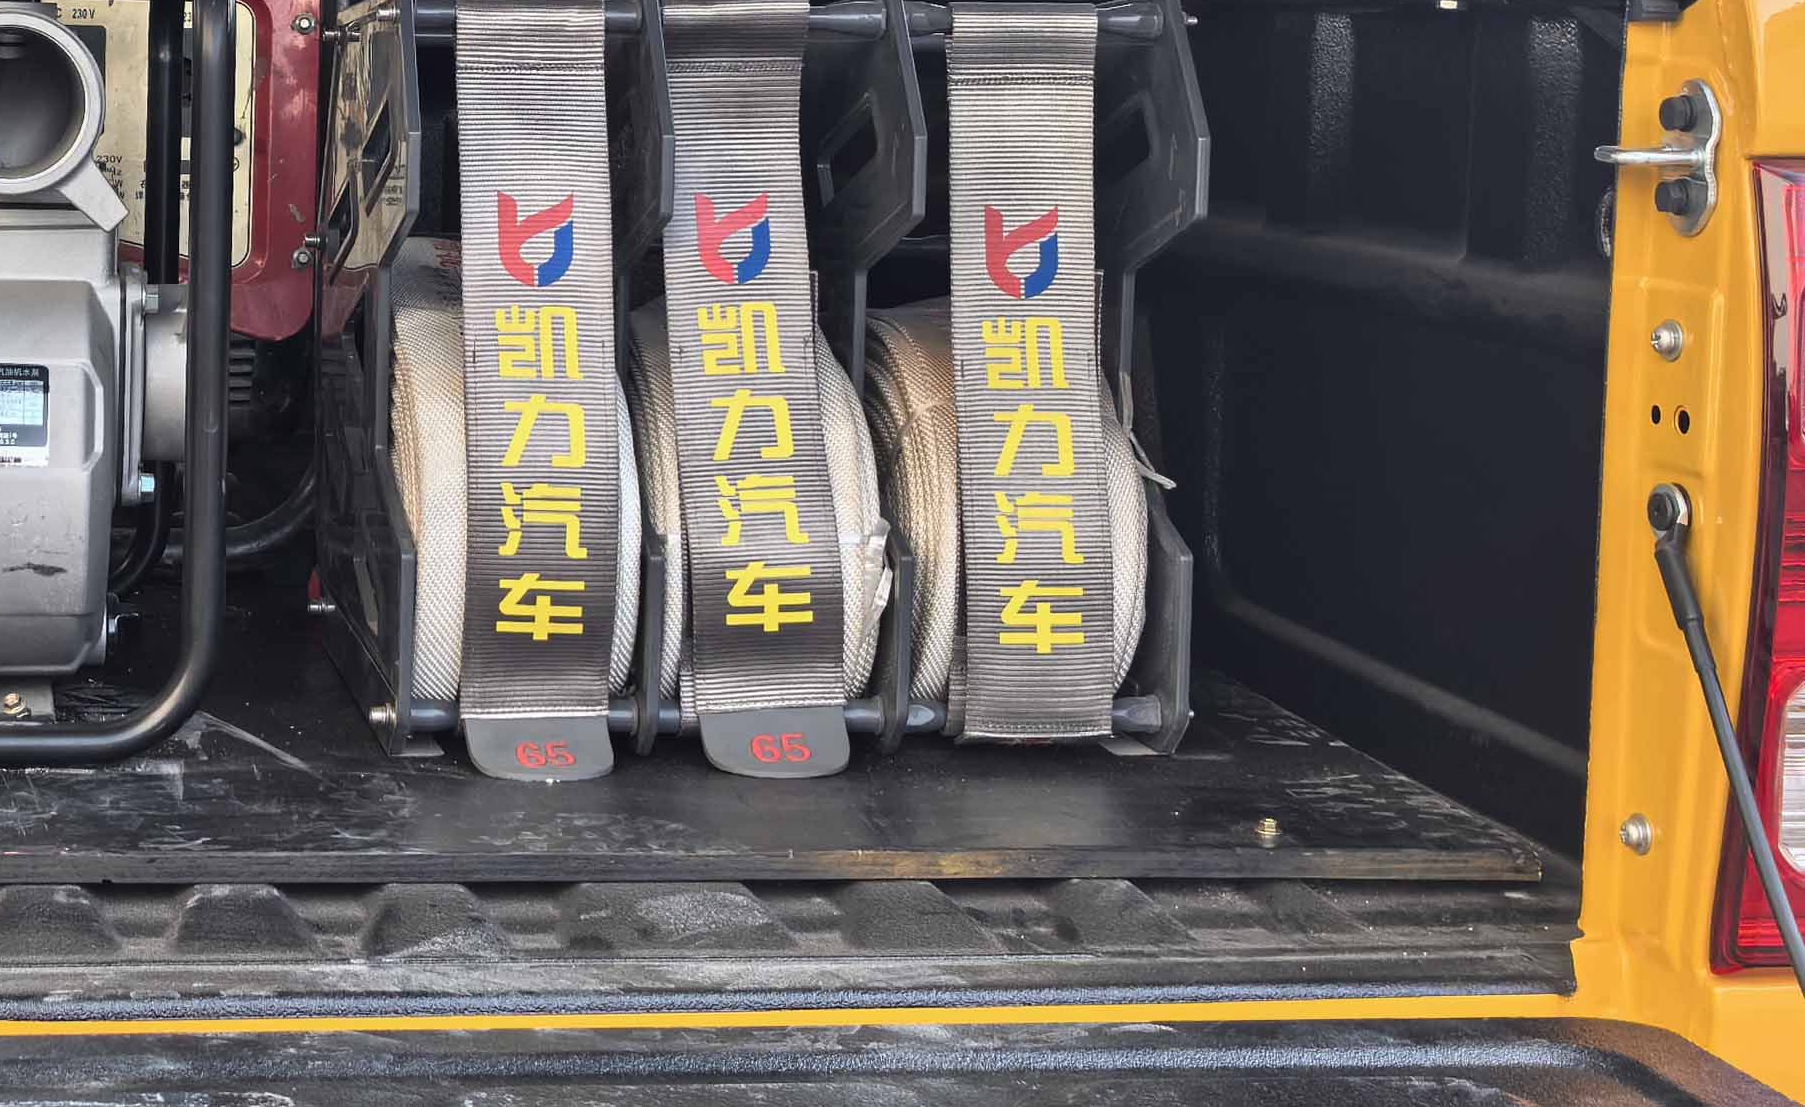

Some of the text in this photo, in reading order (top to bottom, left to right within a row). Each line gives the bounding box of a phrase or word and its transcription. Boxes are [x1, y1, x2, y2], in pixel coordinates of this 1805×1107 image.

[495, 306, 588, 642] 凯力汽车
[697, 302, 814, 633] 凯力汽车
[982, 317, 1086, 655] 凯力汽车
[514, 740, 577, 769] 65
[749, 732, 813, 764] 65
